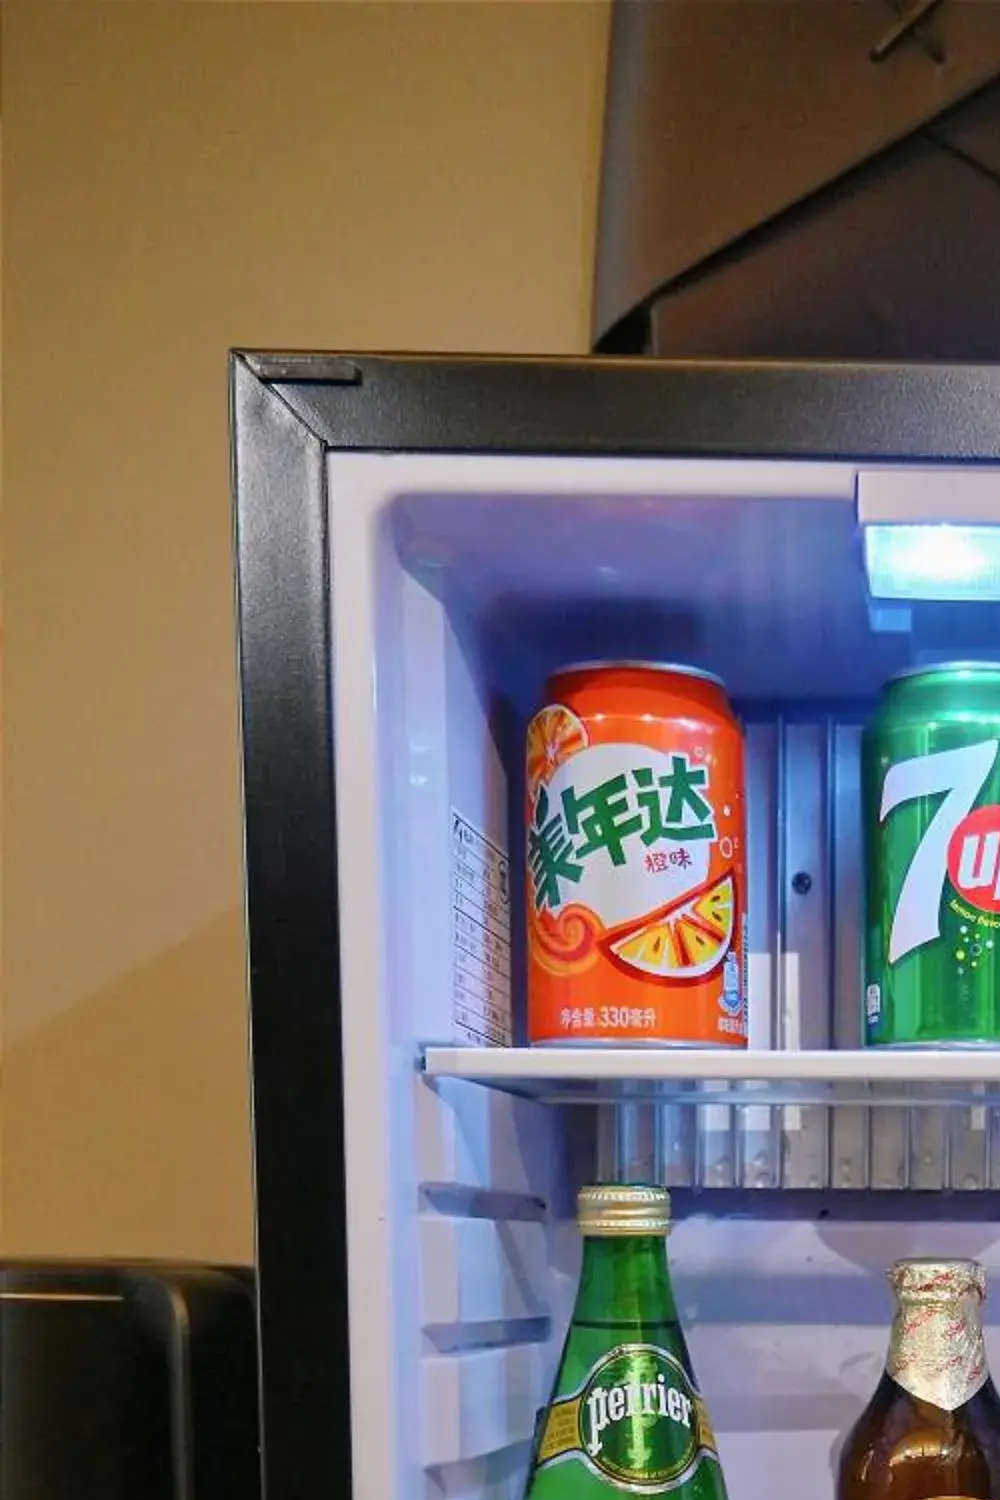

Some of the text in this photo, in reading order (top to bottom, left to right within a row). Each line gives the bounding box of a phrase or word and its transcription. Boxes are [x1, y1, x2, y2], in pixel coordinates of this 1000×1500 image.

[529, 756, 716, 910] 美年达
[645, 846, 693, 873] 橙味
